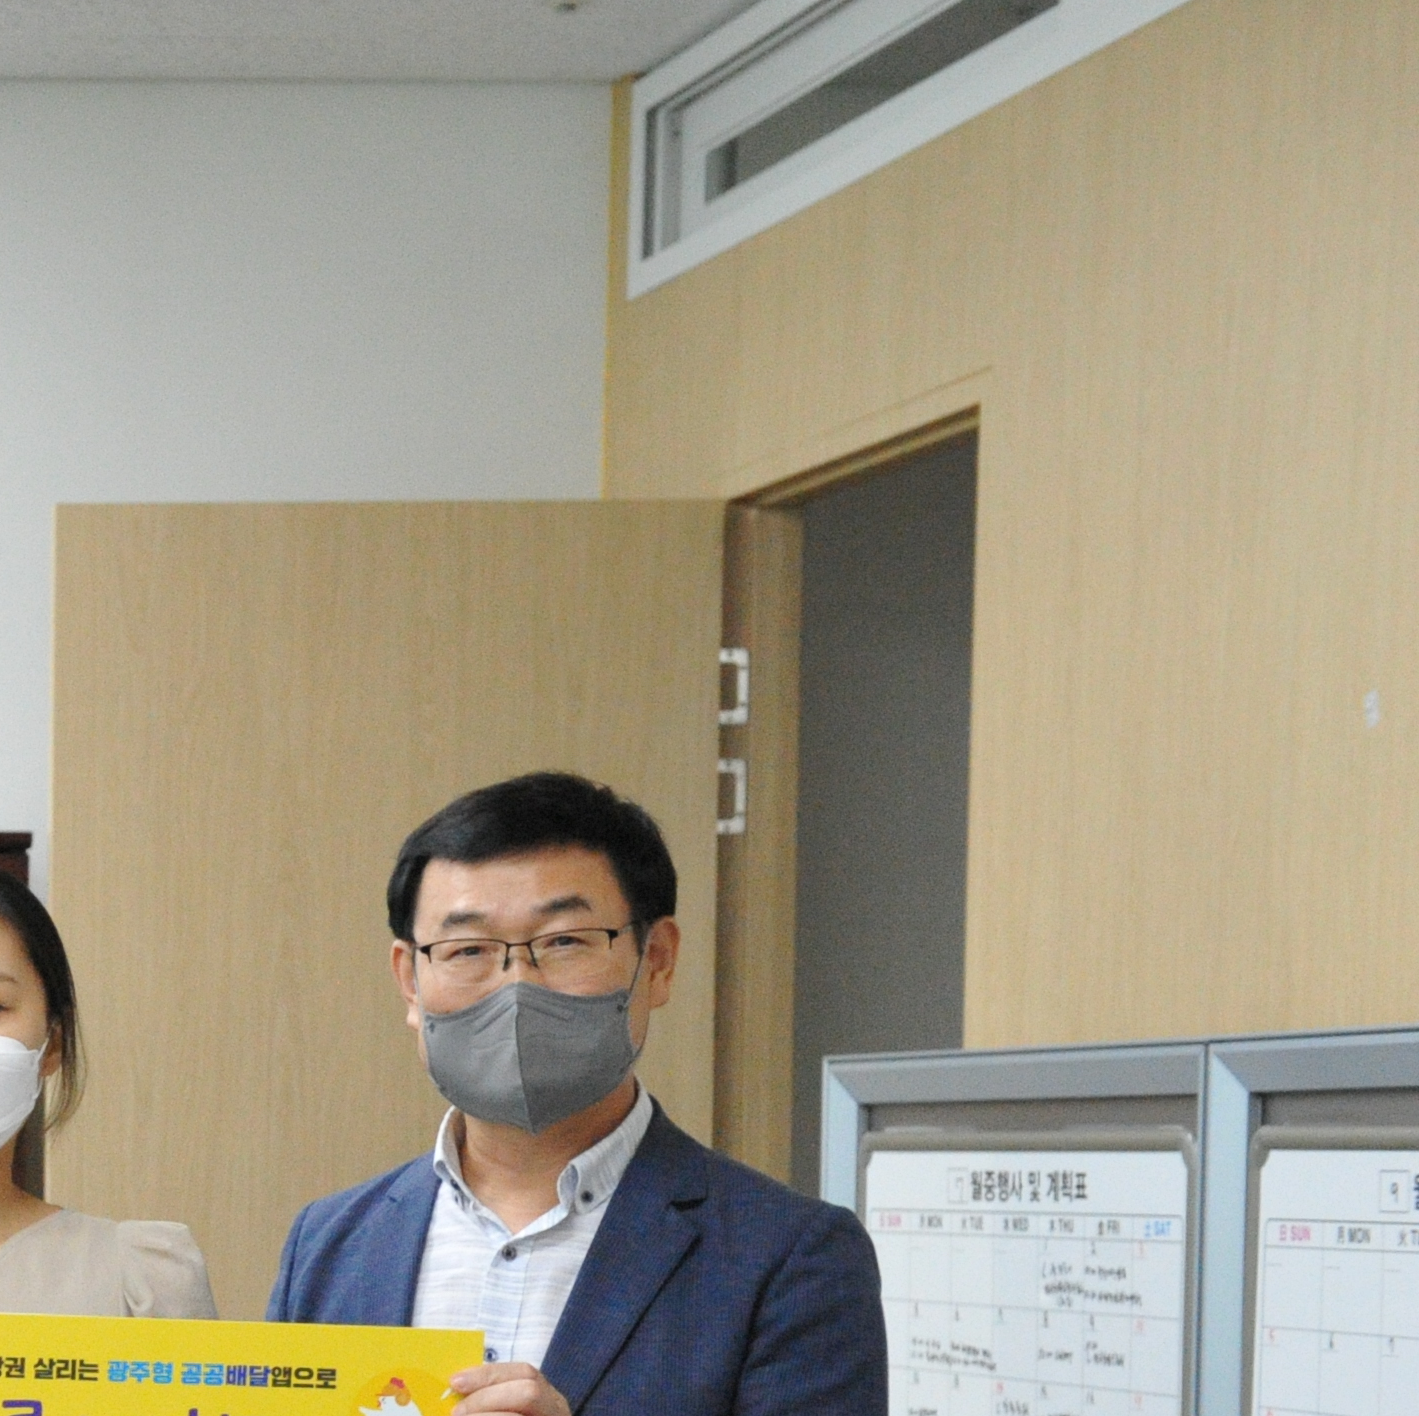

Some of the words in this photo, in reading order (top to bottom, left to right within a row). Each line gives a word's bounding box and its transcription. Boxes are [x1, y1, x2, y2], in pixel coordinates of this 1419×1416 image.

[971, 1170, 1023, 1202] 월중행사
[1028, 1171, 1040, 1202] 및
[1047, 1171, 1086, 1202] 계획표
[1107, 1222, 1120, 1234] FRI
[34, 1358, 99, 1381] 살리는
[107, 1360, 173, 1385] 광주형
[181, 1362, 336, 1390] 공공배달앱으로
